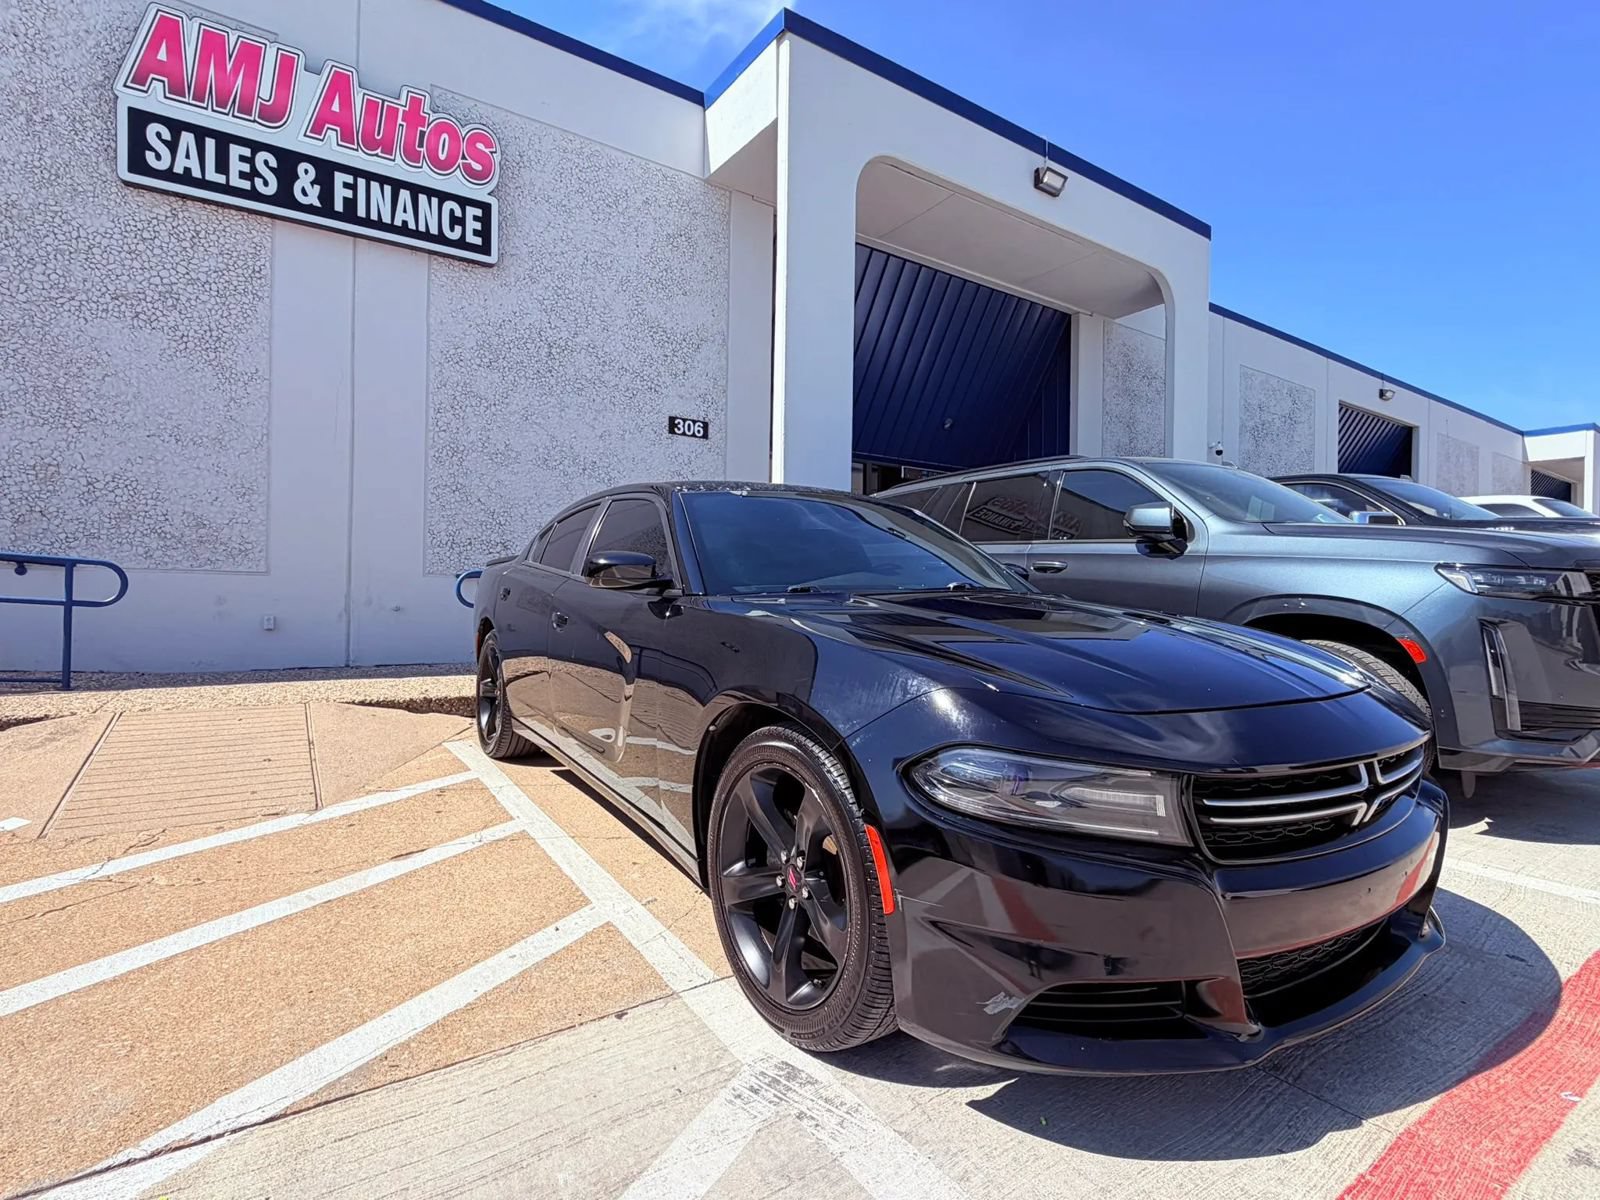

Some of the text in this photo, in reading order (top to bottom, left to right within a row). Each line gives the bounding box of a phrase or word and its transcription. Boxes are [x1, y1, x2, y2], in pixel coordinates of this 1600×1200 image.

[126, 10, 498, 185] AMJ Autos
[145, 123, 483, 246] SALES & FINANCE
[674, 419, 704, 437] 306
